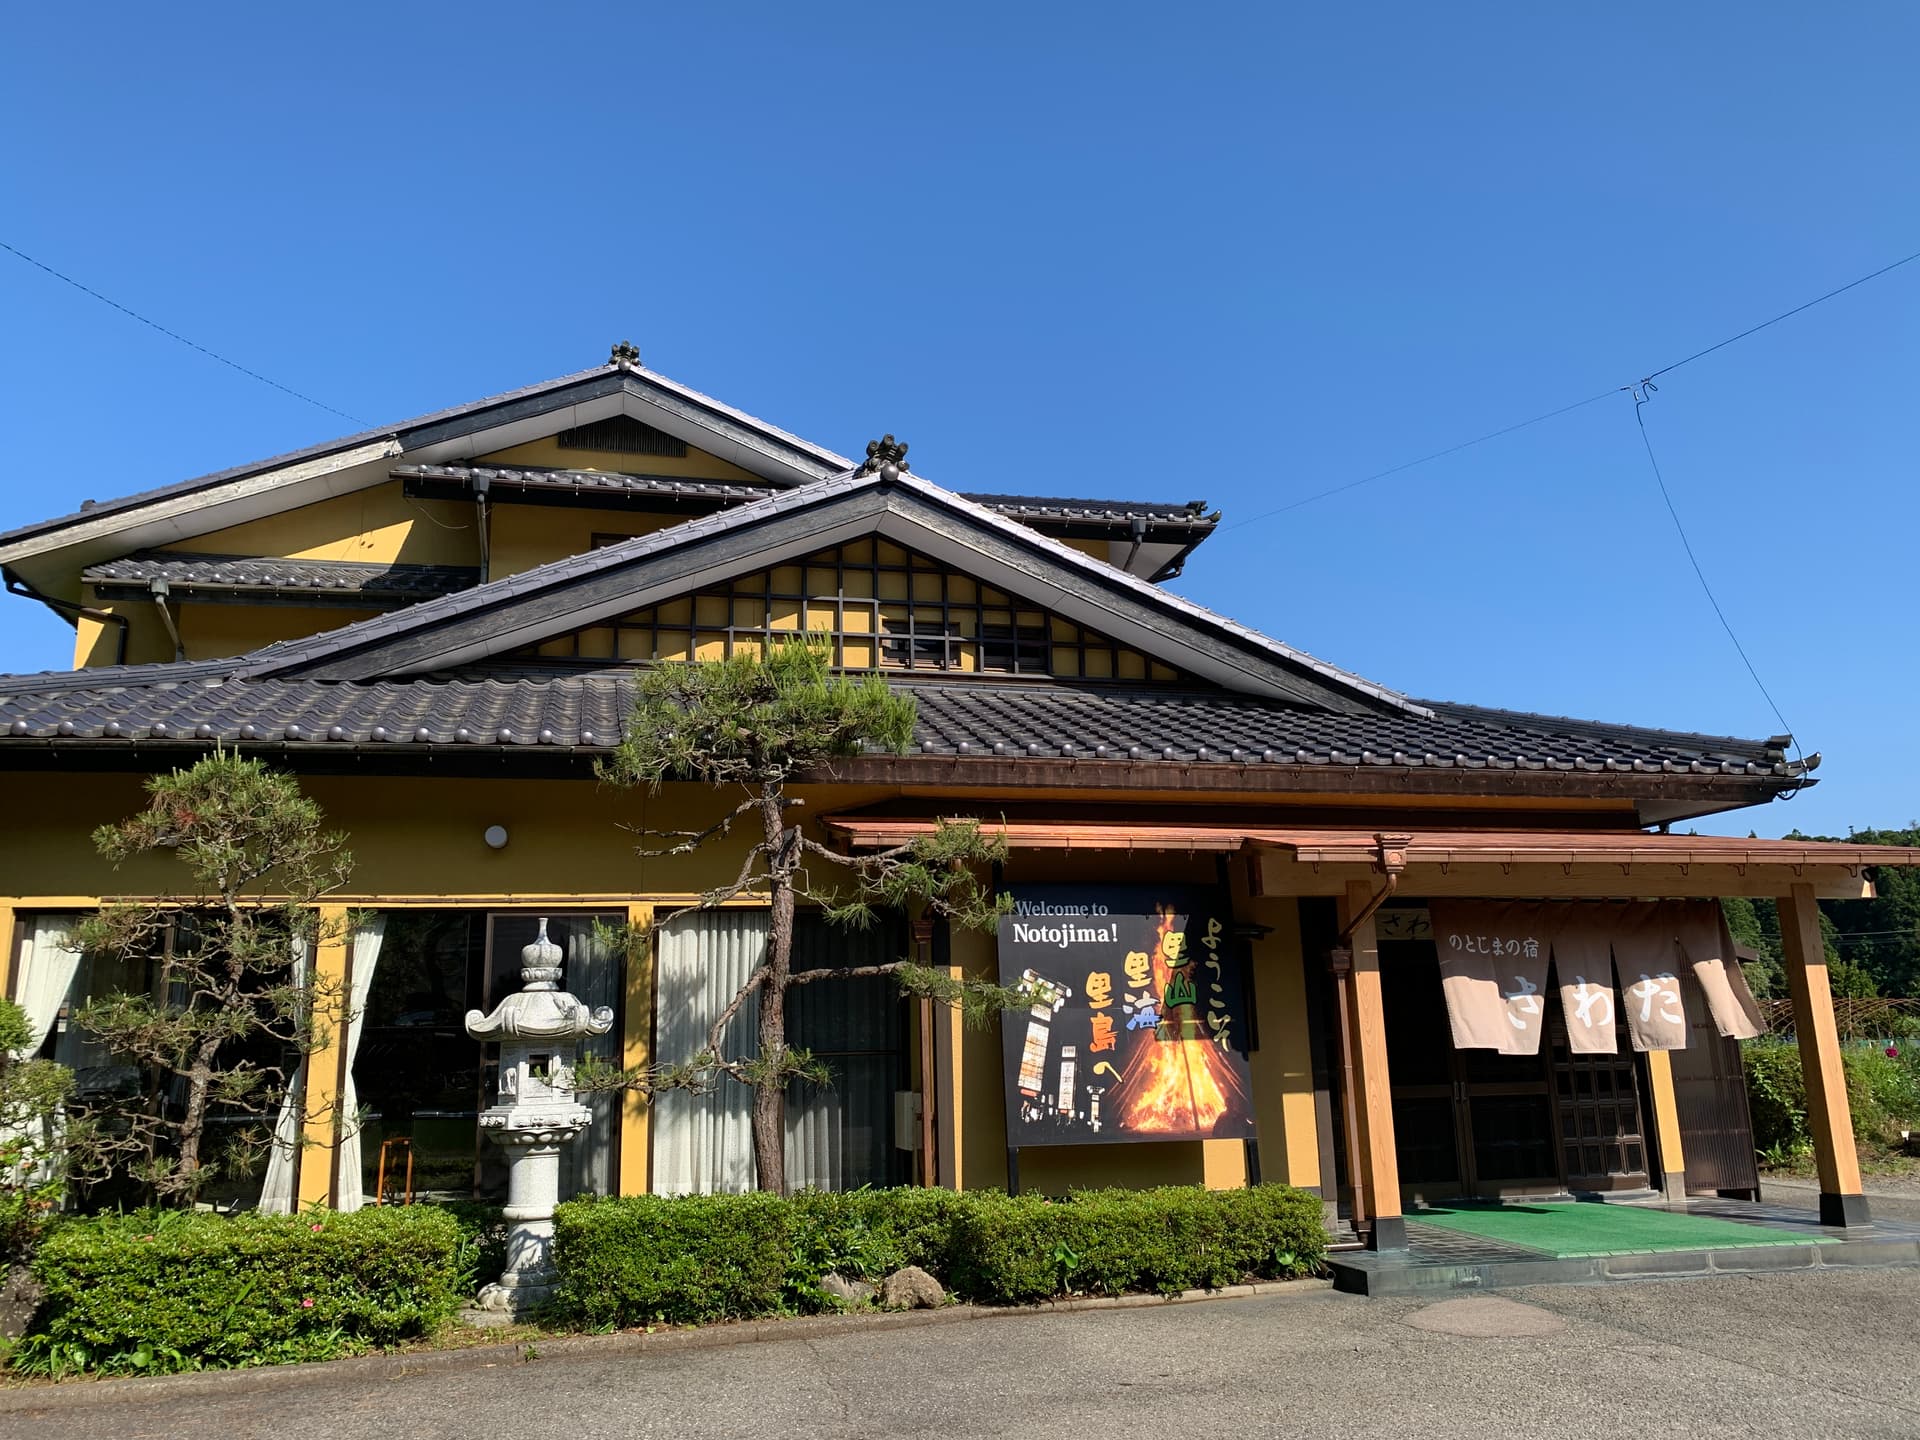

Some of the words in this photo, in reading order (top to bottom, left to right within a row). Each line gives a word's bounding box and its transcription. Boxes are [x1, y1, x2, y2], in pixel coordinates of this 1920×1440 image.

[1013, 923, 1119, 948] Notojima!
[1015, 900, 1089, 917] Welcome
[1091, 902, 1109, 917] to
[1162, 930, 1197, 1008] 里山
[1449, 934, 1540, 960] のとじまの宿
[1122, 950, 1163, 1031] 里海
[1201, 917, 1232, 1053] ようこそ
[1504, 972, 1683, 1030] さわだ
[1085, 971, 1125, 1084] 里島へ
